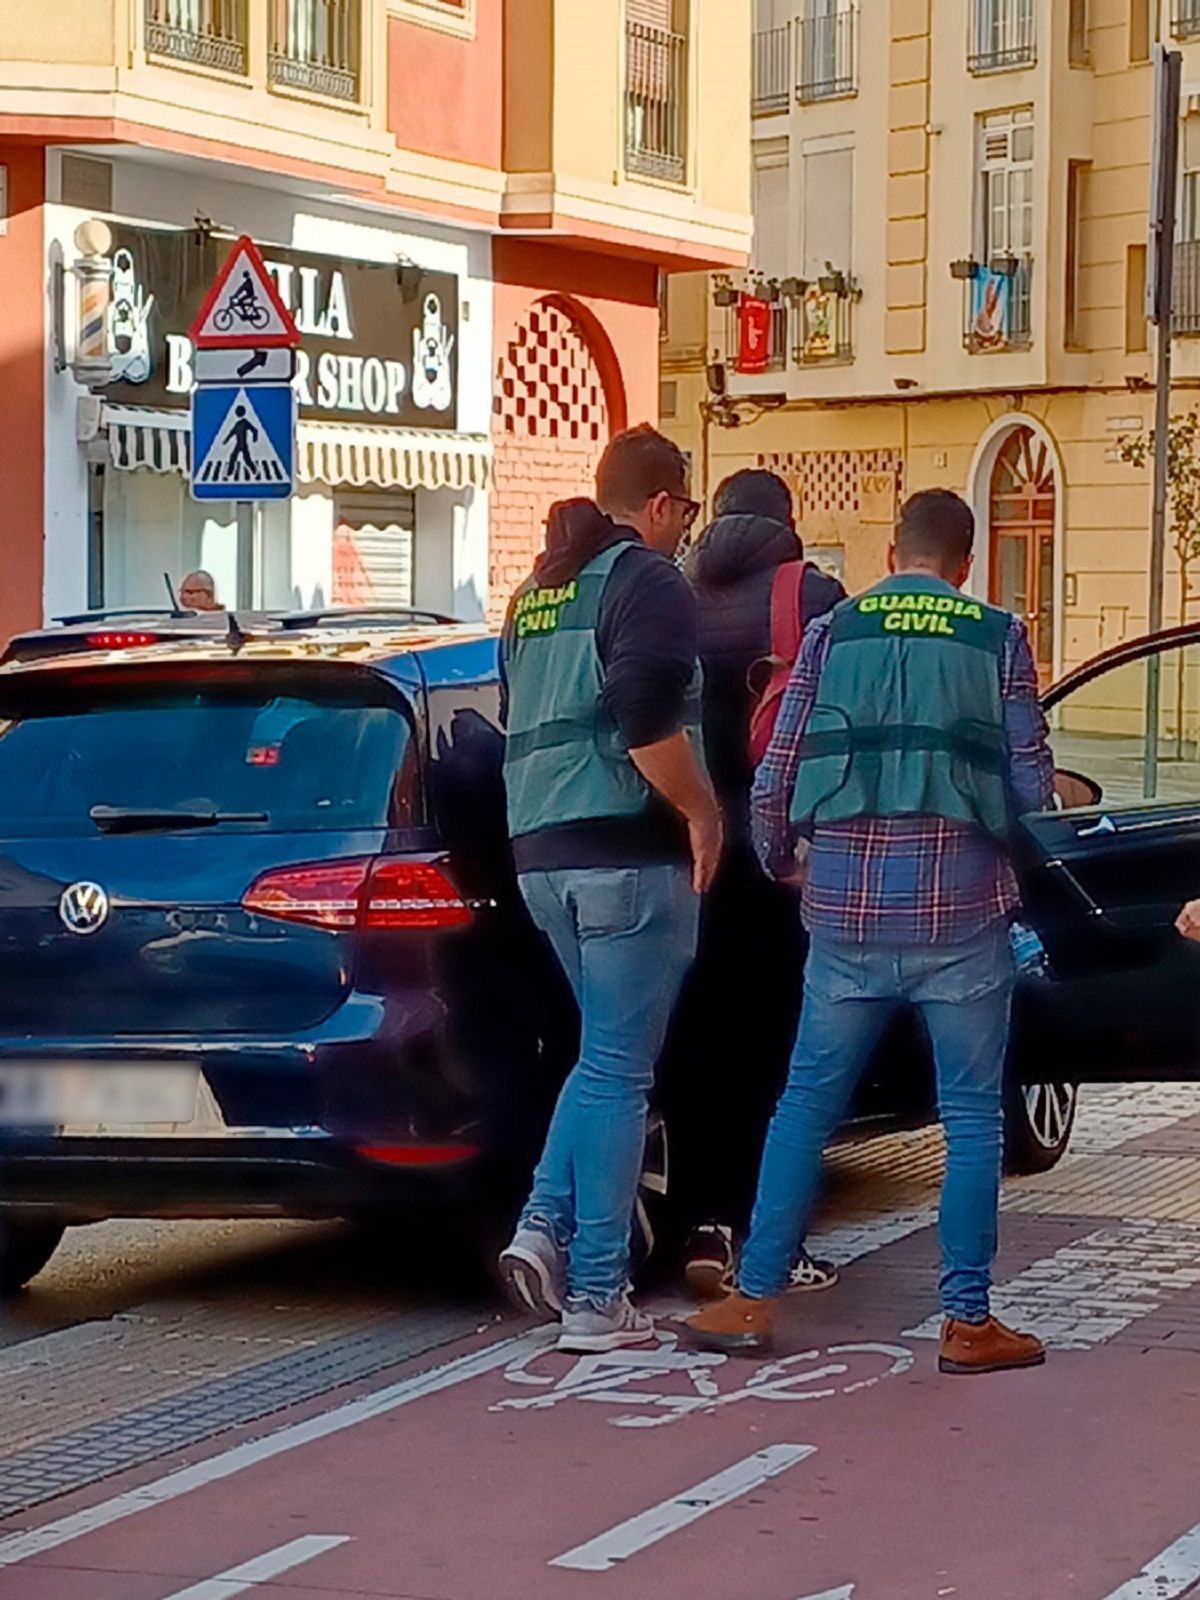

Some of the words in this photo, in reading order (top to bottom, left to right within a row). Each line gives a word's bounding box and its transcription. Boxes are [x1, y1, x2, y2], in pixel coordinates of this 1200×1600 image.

[263, 260, 354, 340] LLA
[317, 352, 406, 413] SHOP
[859, 594, 982, 620] GUARDIA
[884, 612, 955, 635] CIVIL
